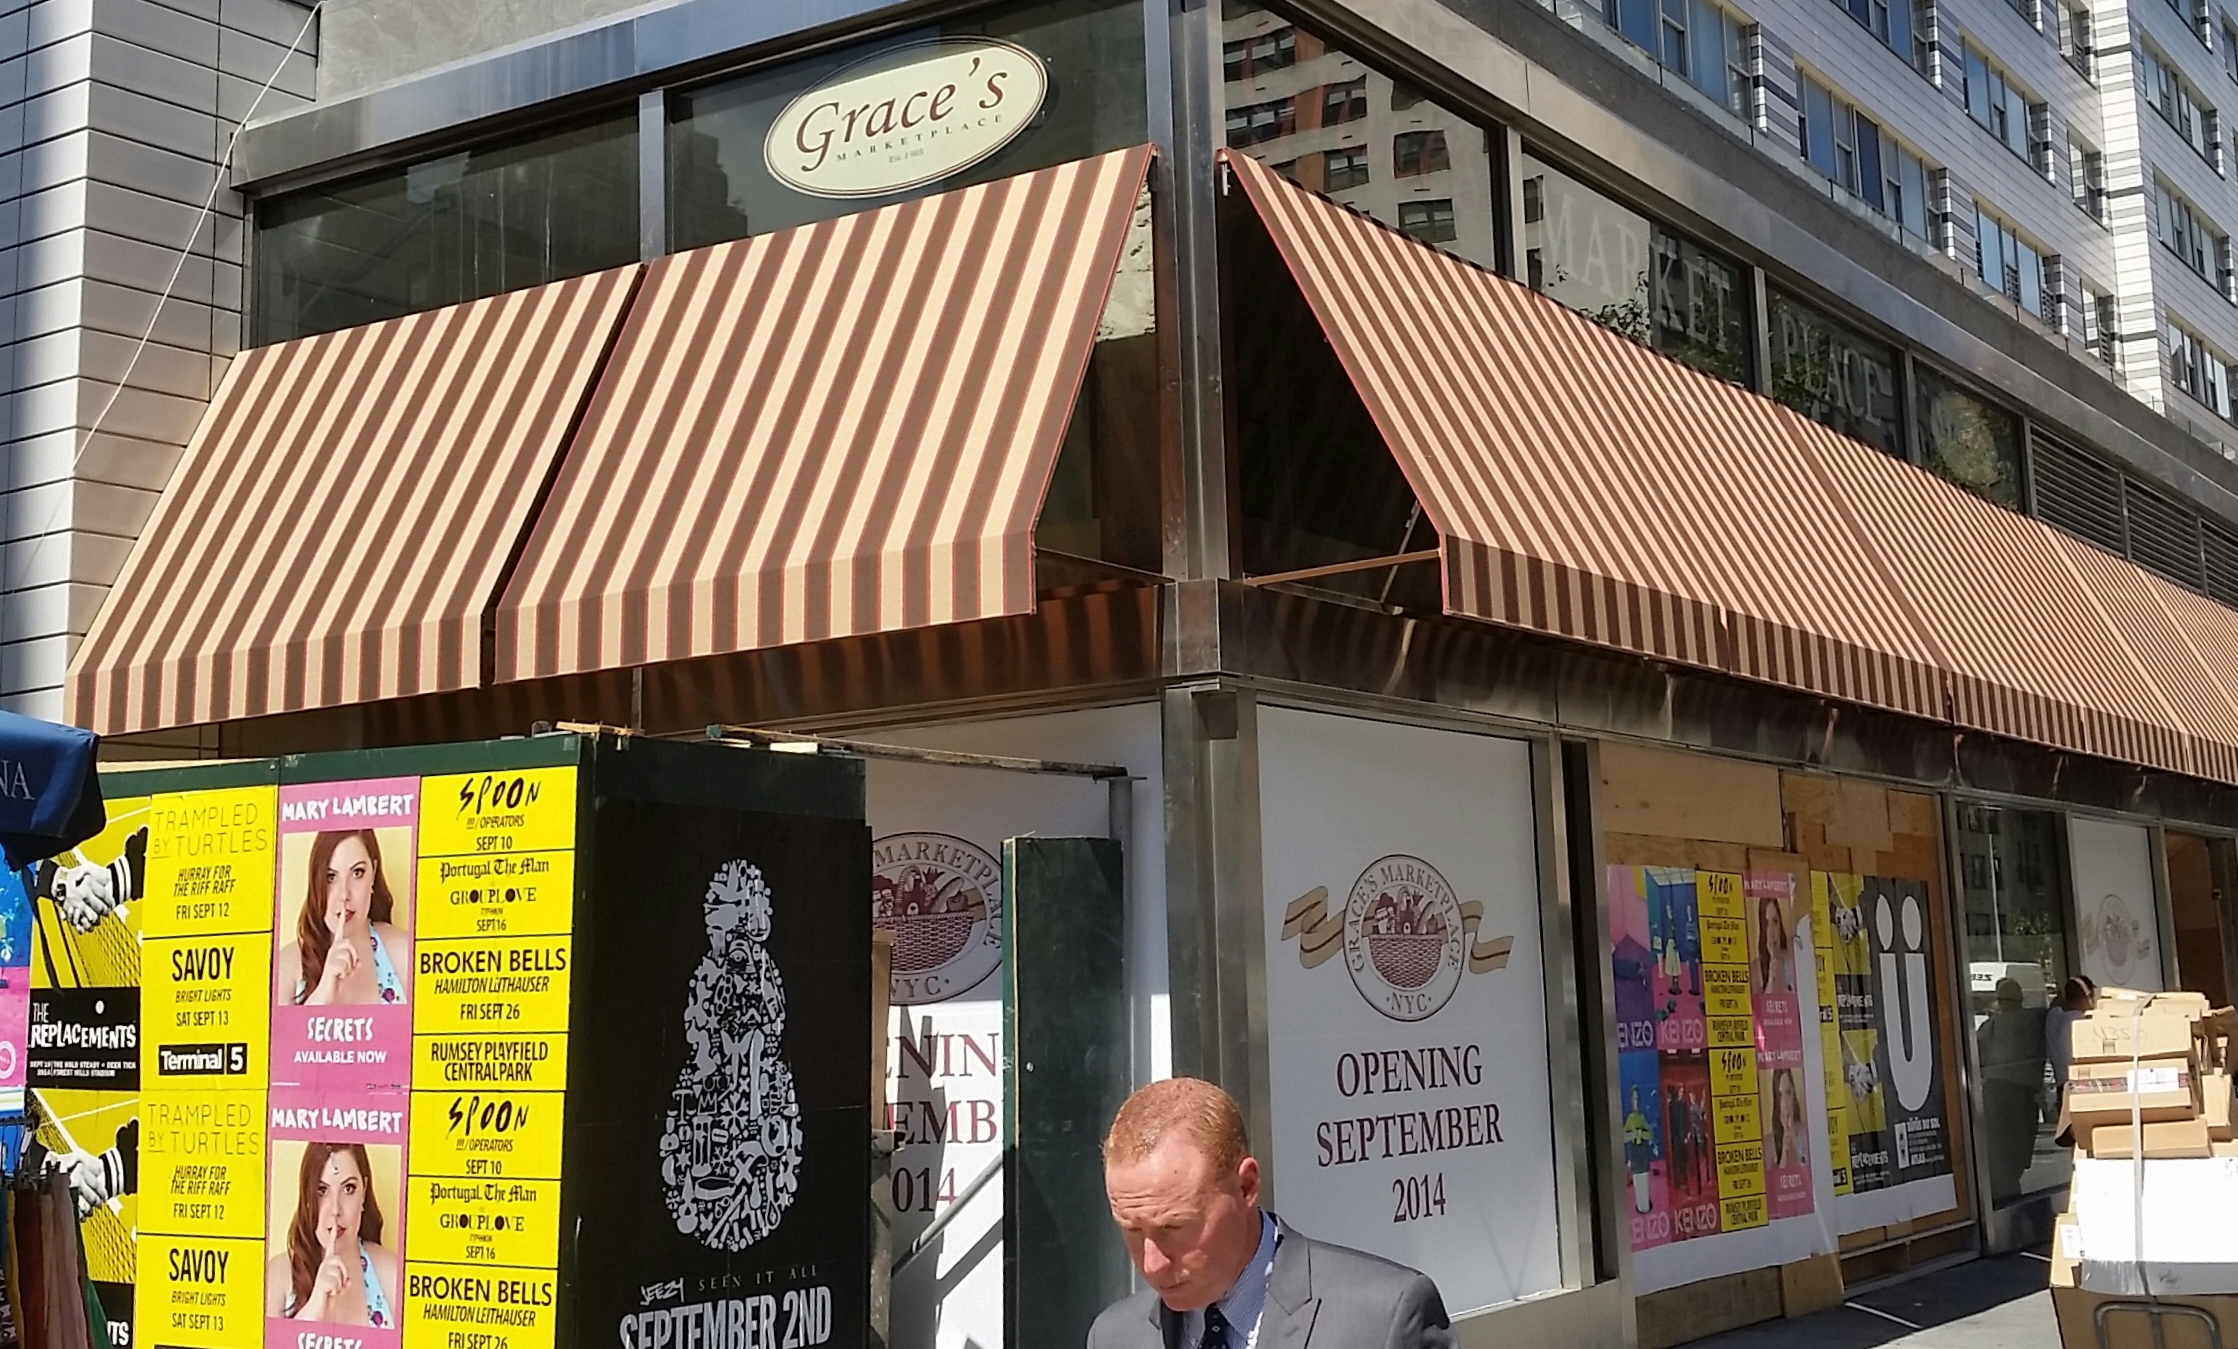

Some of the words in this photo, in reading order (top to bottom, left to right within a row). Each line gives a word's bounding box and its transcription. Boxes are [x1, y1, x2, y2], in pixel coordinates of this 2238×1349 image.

[795, 56, 1008, 172] Grace's
[837, 114, 1003, 163] MARKETPLACE
[281, 799, 328, 822] MARY
[332, 794, 415, 817] LAMBERT
[456, 775, 541, 820] SPOON
[155, 803, 258, 832] TRAMPLED
[152, 837, 171, 858] BY
[175, 829, 268, 857] TURTLES
[476, 836, 498, 851] SEPT
[501, 835, 513, 850] 10
[177, 866, 212, 882] HURRAY
[213, 865, 232, 879] FOR
[493, 858, 518, 876] The
[518, 858, 549, 875] Man
[174, 882, 189, 897] THE
[190, 881, 211, 896] RIFF
[212, 879, 236, 894] RAFF
[450, 887, 537, 905] GROUPLOVE
[176, 905, 191, 920] FRI
[193, 903, 215, 919] SEPT
[218, 902, 230, 918] 12
[1348, 874, 1379, 973] GRACE'S
[1380, 864, 1462, 971] MARKETPLACE
[476, 919, 496, 932] SEPT
[496, 918, 507, 931] 16
[171, 947, 235, 982] SAVOY
[420, 950, 502, 975] BROKEN
[509, 948, 567, 972] BELLS
[434, 977, 488, 995] HAMILTON
[1704, 969, 1731, 983] BROKEN
[1732, 969, 1749, 983] BELLS
[175, 989, 203, 1003] BRIGHT
[204, 988, 232, 1002] LIGHTS
[32, 1002, 50, 1023] THE
[176, 1012, 191, 1027] SAT
[193, 1010, 215, 1026] SEPT
[218, 1010, 229, 1026] 13
[460, 1004, 477, 1020] FRI
[479, 1003, 504, 1020] SEPT
[506, 1003, 521, 1020] 26
[30, 1020, 137, 1049] REPLACEMENTS
[307, 1016, 374, 1042] SECRETS
[1617, 1020, 1654, 1048] ENZO
[1660, 1019, 1704, 1045] KENZO
[160, 1048, 223, 1071] Terminal
[229, 1046, 243, 1071] 5
[293, 1050, 355, 1063] AVAILABLE
[357, 1050, 388, 1063] NOW
[431, 1042, 483, 1062] RUMSEY
[484, 1041, 549, 1061] PLAYFIELD
[444, 1062, 498, 1082] CENTRAL
[500, 1062, 533, 1082] PARK
[1336, 1044, 1483, 1098] OPENING
[147, 1103, 251, 1128] TRAMPLED
[271, 1108, 319, 1129] MARY
[322, 1107, 403, 1134] LAMBERT
[446, 1095, 529, 1139] SPOON
[148, 1133, 165, 1152] BY
[170, 1131, 260, 1156] TURTLES
[1316, 1103, 1504, 1168] SEPTEMBER
[1717, 1149, 1744, 1165] BROKEN
[1745, 1147, 1762, 1162] BELLS
[175, 1165, 208, 1181] HURRAY
[209, 1166, 227, 1180] FOR
[466, 1159, 488, 1175] SEPT
[490, 1160, 502, 1175] 10
[171, 1179, 187, 1195] THE
[188, 1180, 208, 1195] RIFF
[208, 1181, 231, 1196] RAFF
[484, 1183, 506, 1203] The
[508, 1184, 537, 1202] Man
[1392, 1172, 1447, 1223] 2014
[173, 1203, 188, 1218] FRI
[189, 1204, 212, 1219] SEPT
[214, 1204, 225, 1220] 12
[440, 1213, 525, 1232] GROUPLOVE
[1632, 1211, 1670, 1242] ENZO
[1674, 1203, 1718, 1235] KENZO
[465, 1246, 485, 1259] SEPT
[486, 1247, 496, 1260] 16
[169, 1248, 229, 1284] SAVOY
[698, 1273, 742, 1291] SEEN
[756, 1270, 774, 1285] IT
[788, 1264, 818, 1280] ALL
[171, 1290, 199, 1305] BRIGHT
[199, 1291, 226, 1307] LIGHTS
[409, 1275, 491, 1302] BROKEN
[498, 1280, 552, 1306] BELLS
[172, 1313, 186, 1329] SAT
[189, 1313, 211, 1330] SEPT
[213, 1315, 224, 1331] 13
[423, 1303, 478, 1323] HAMILTON
[475, 1307, 536, 1327] LEITHAUSER
[619, 1294, 777, 1349] SEPTEMBER
[782, 1286, 832, 1349] 2ND
[448, 1331, 465, 1349] FRI
[467, 1333, 492, 1349] SEPT
